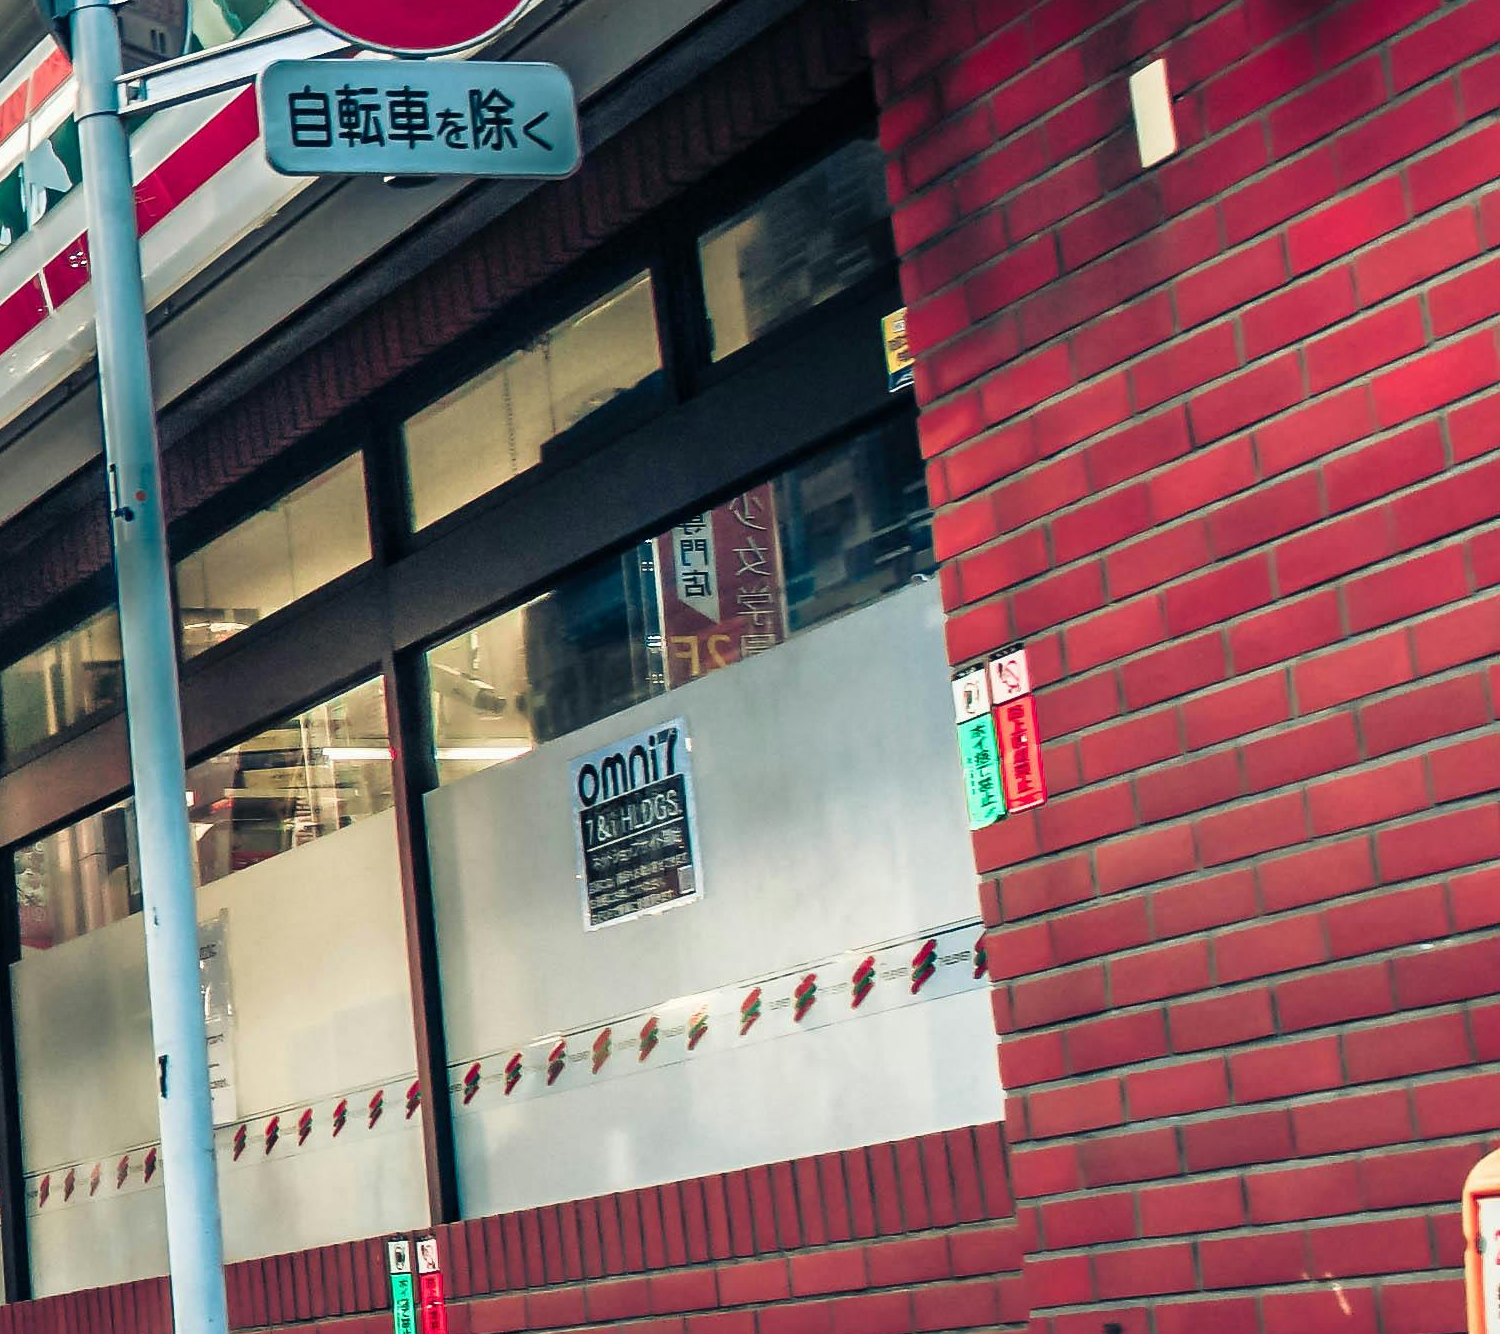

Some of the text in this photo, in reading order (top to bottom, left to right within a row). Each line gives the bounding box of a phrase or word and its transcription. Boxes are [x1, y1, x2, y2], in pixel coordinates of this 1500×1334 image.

[288, 84, 554, 152] 自転車を除く
[578, 727, 678, 807] omni7
